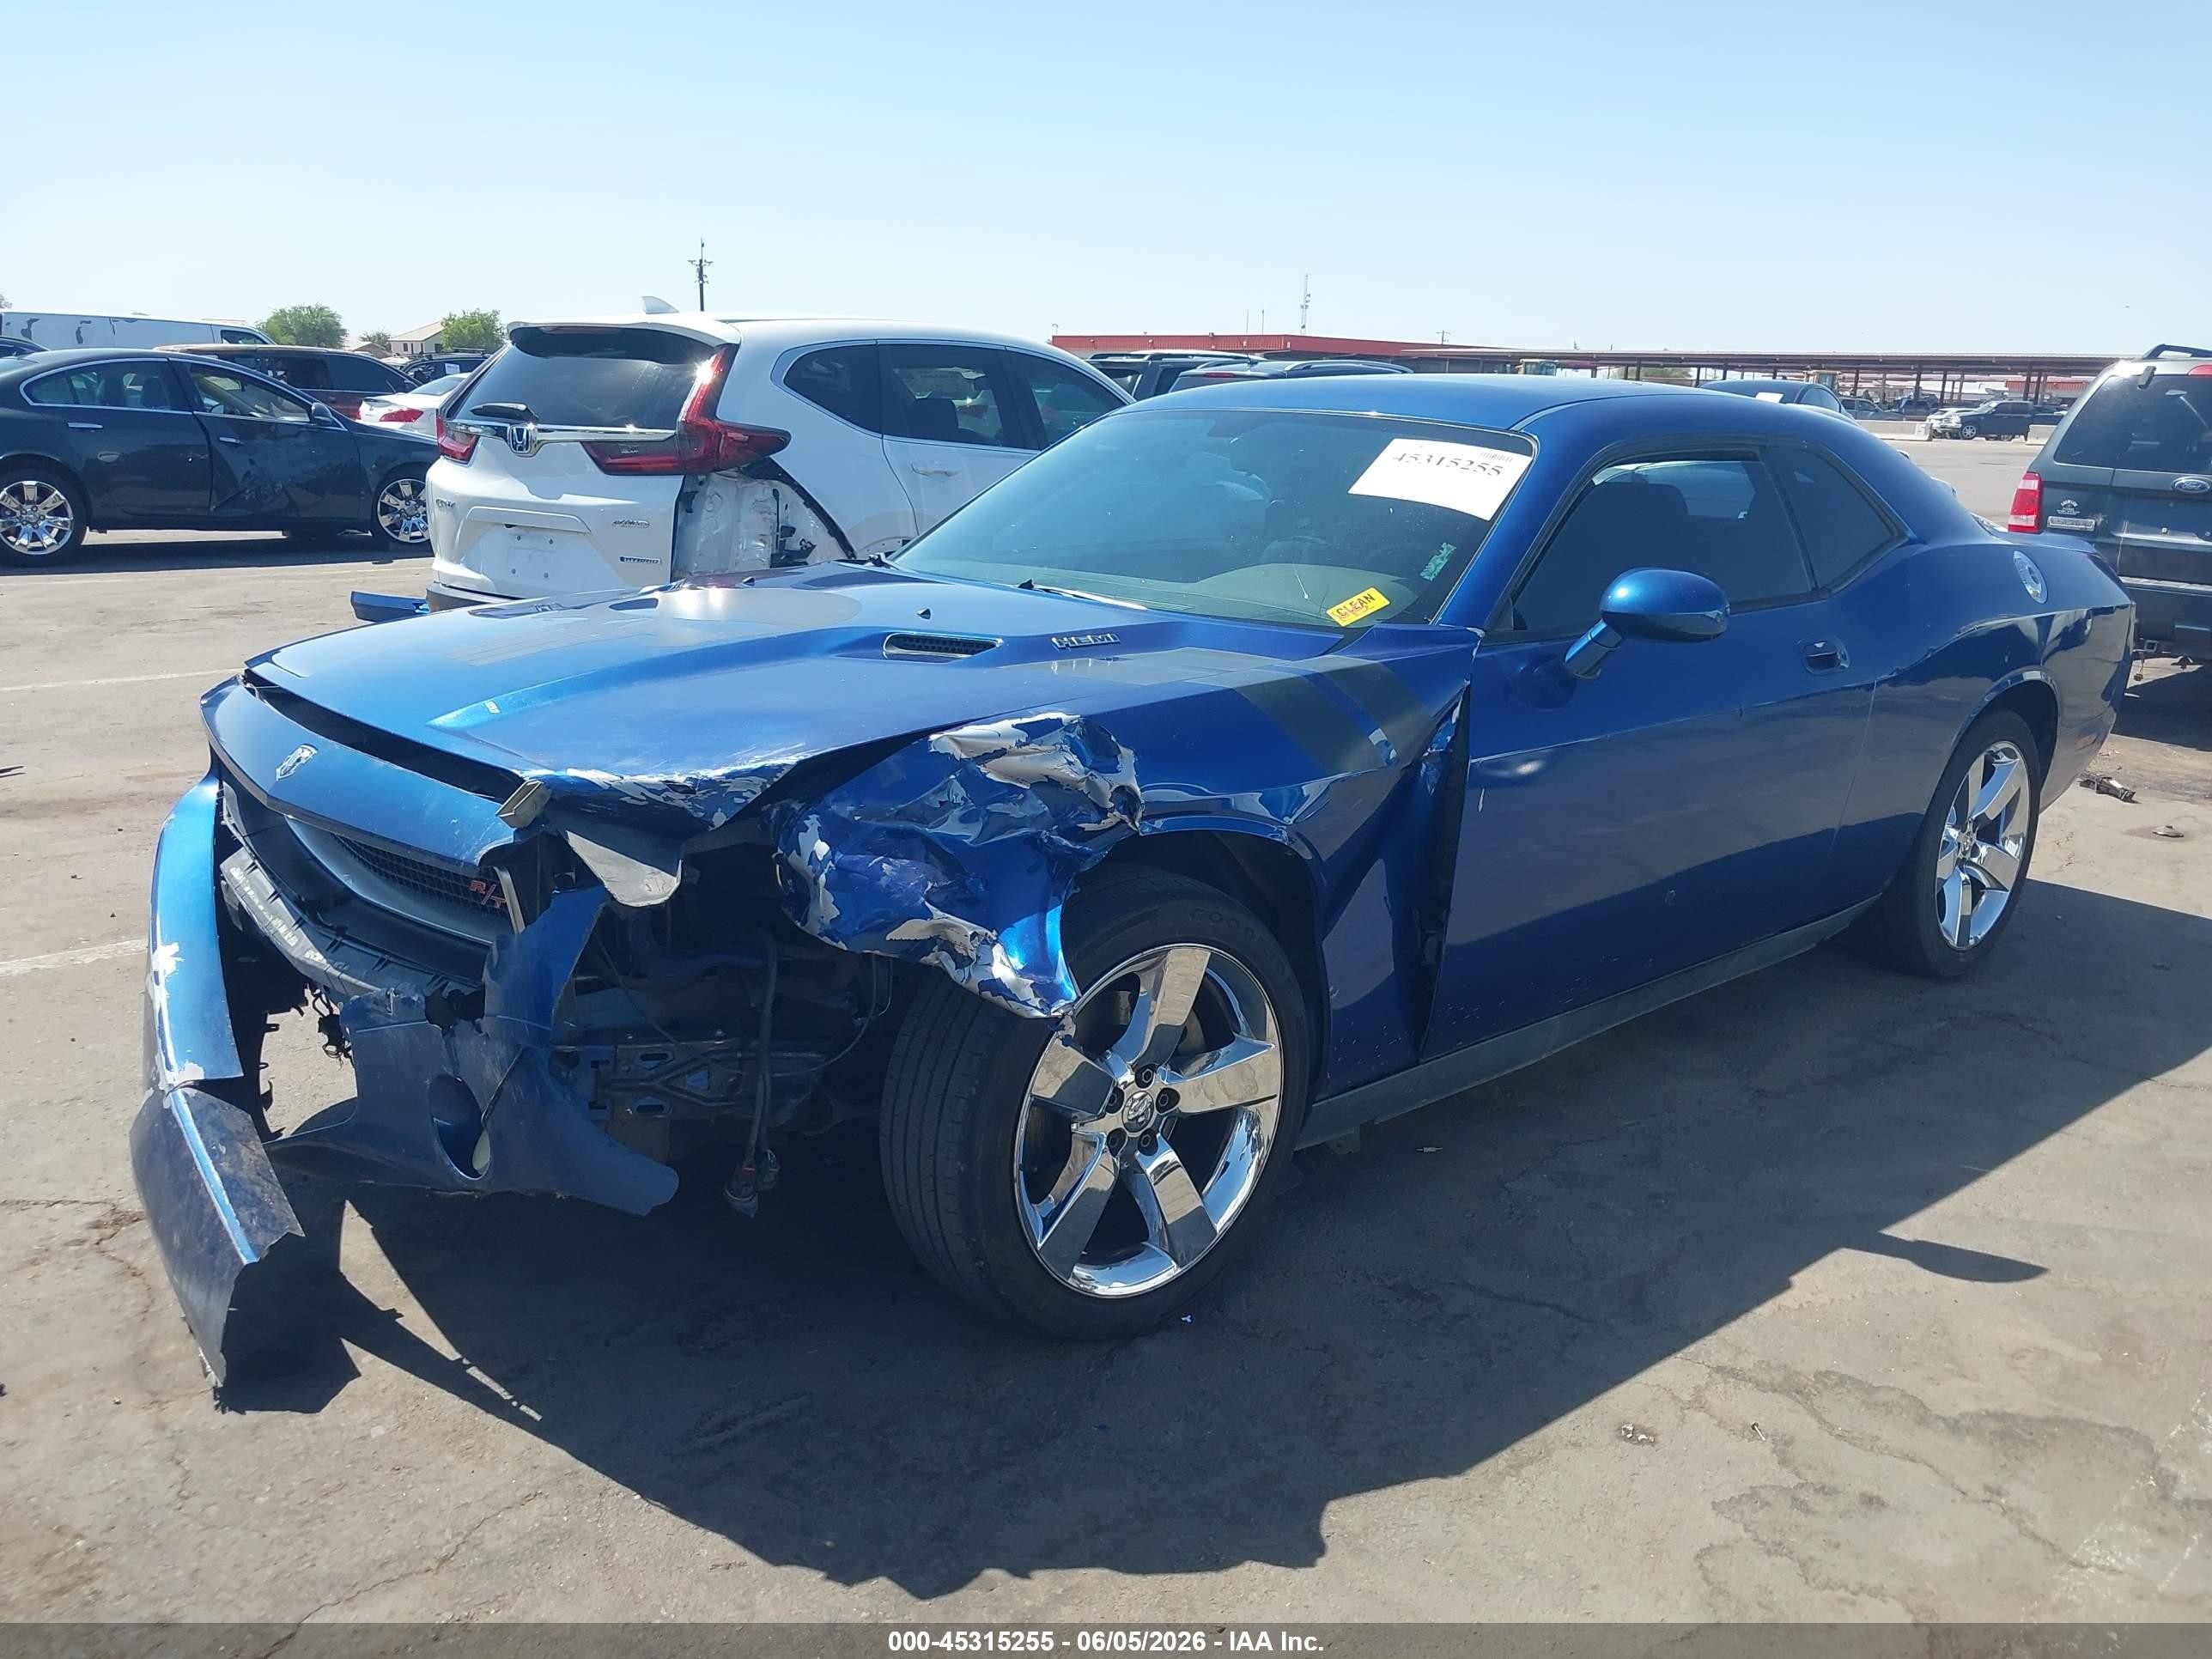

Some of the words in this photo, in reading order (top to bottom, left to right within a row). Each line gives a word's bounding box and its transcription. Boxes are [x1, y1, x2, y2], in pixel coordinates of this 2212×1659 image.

[1393, 453, 1504, 477] 45315255
[1336, 593, 1376, 617] CLEAN
[1051, 634, 1121, 650] HEMI
[471, 879, 506, 908] R/T
